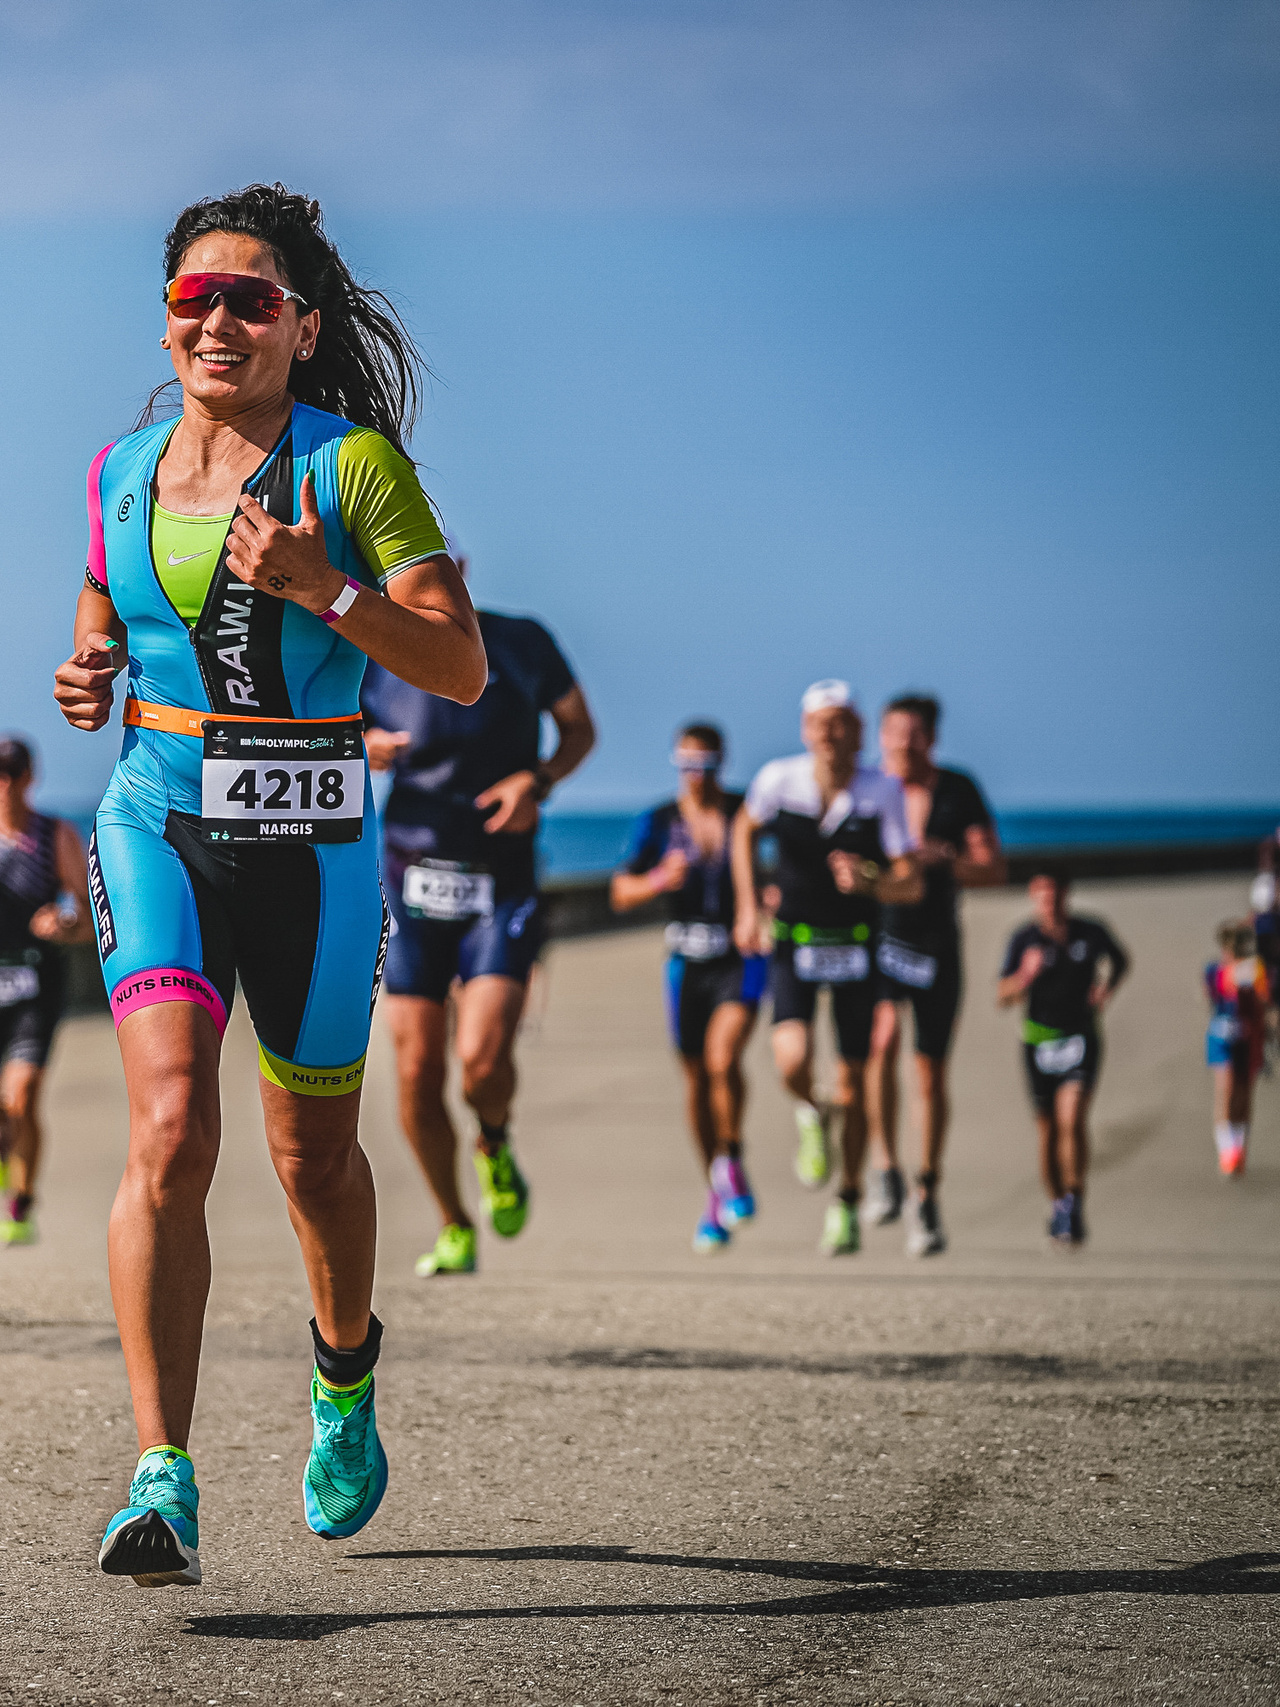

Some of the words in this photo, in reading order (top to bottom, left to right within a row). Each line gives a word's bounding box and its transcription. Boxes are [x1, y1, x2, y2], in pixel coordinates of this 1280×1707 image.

[266, 738, 310, 748] OLYMPIC
[226, 768, 345, 811] 4218
[259, 823, 314, 836] NARGIS
[116, 978, 157, 1007] NUTS
[160, 976, 215, 1005] ENERGY
[292, 1071, 343, 1086] NUTS
